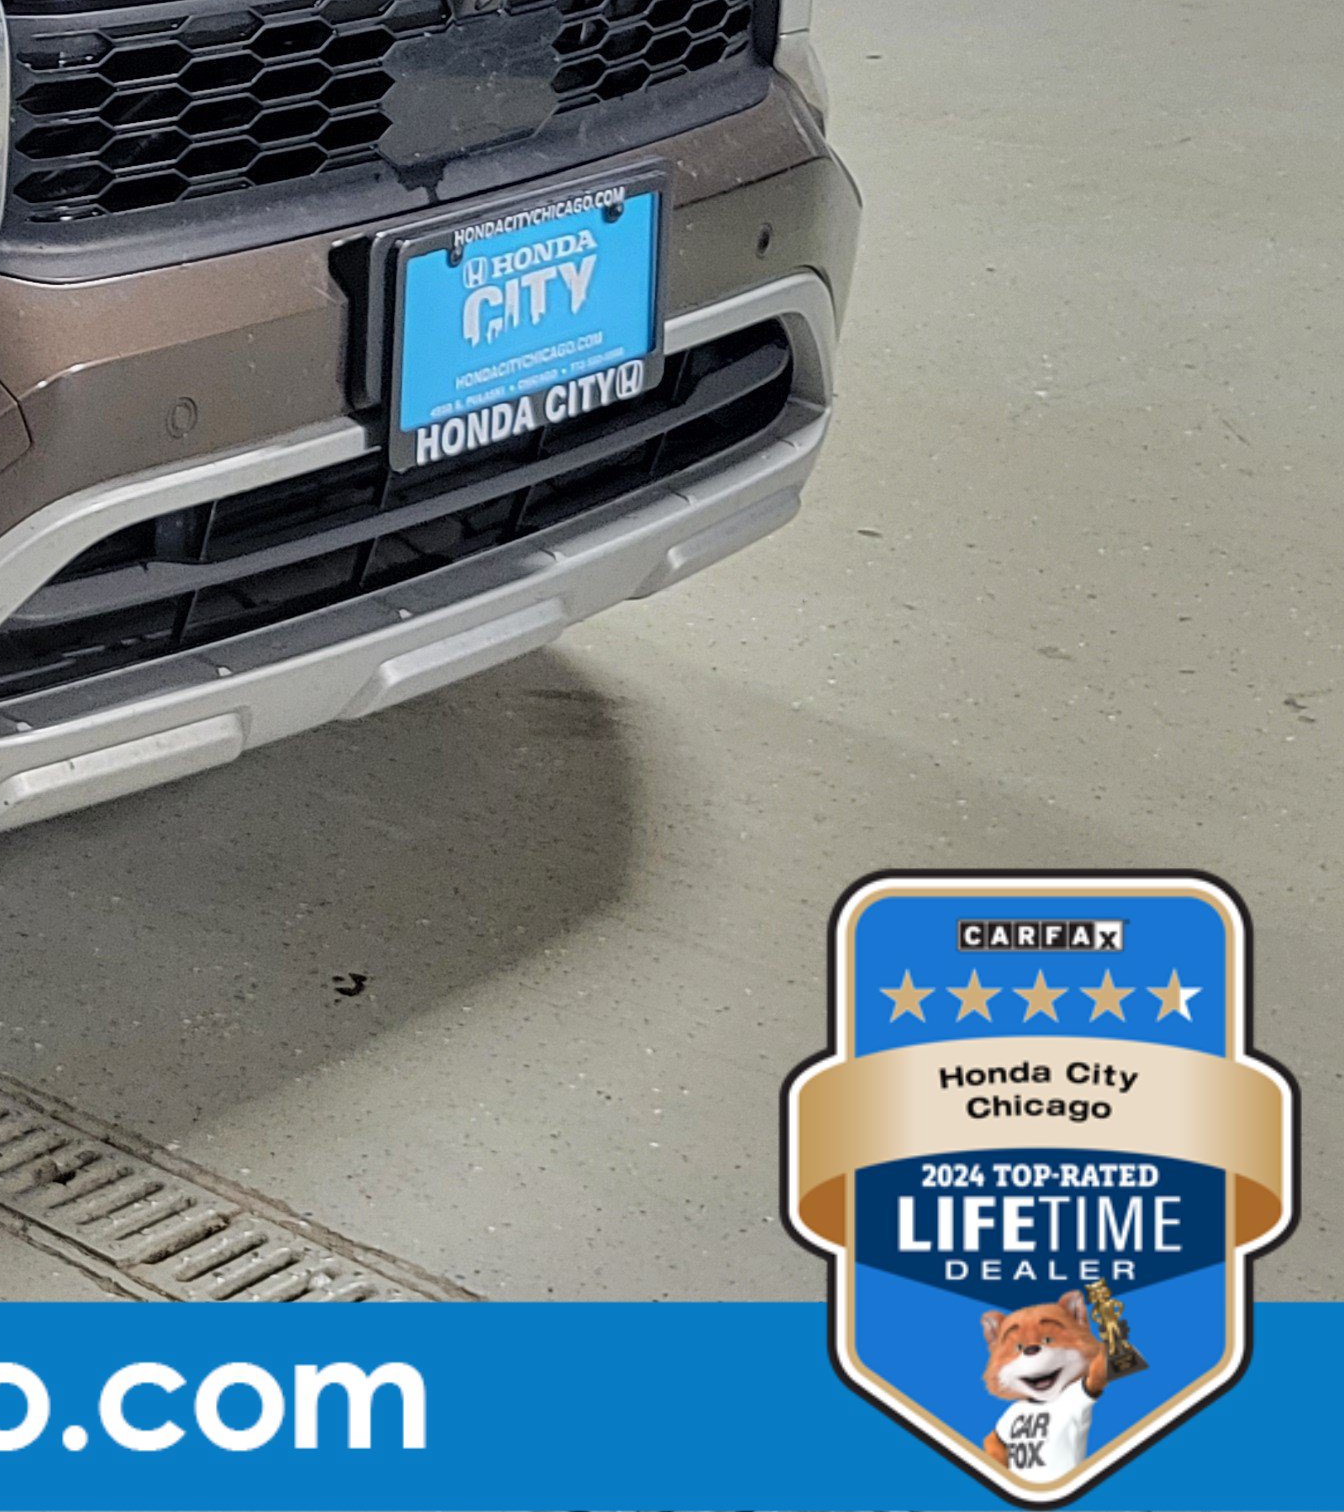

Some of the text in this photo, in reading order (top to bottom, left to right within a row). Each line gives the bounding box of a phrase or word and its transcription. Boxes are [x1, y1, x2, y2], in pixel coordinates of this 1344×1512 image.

[454, 187, 625, 247] HONDACITYCHICAGO.COM
[491, 229, 599, 279] HONDA
[463, 254, 597, 349] CITY
[416, 366, 617, 466] HONDA CITY
